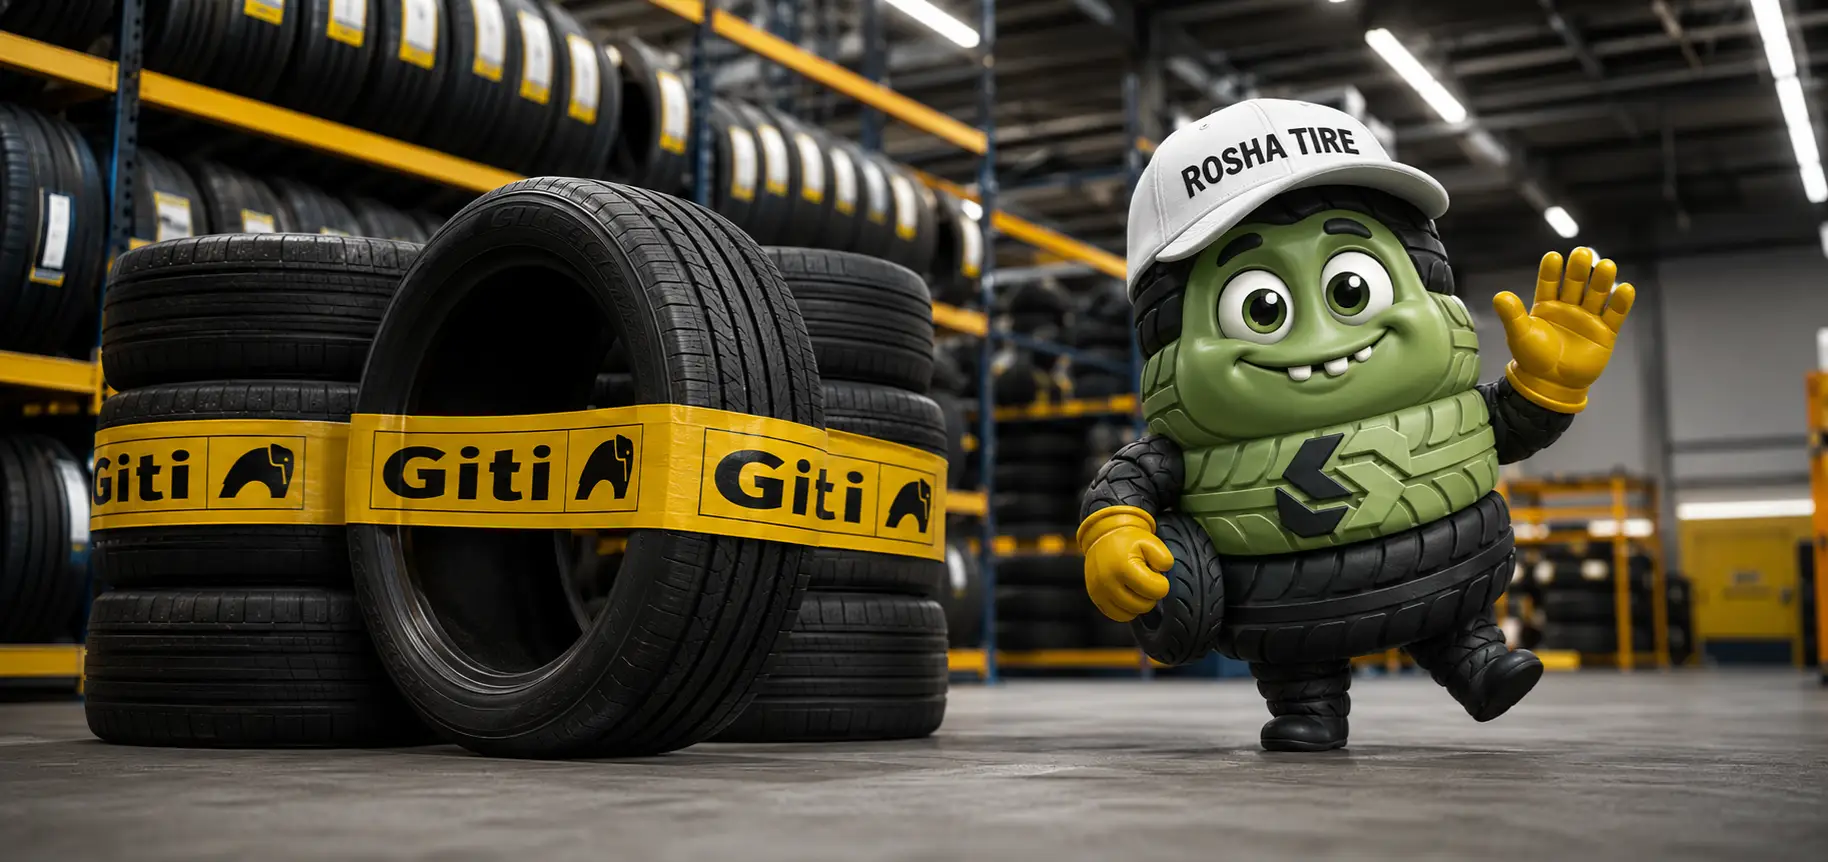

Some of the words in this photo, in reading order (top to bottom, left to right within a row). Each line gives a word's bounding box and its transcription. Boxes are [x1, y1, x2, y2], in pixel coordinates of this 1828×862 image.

[1181, 133, 1288, 199] ROSHA
[1287, 127, 1360, 155] TIRE
[92, 449, 190, 506] Giti
[382, 444, 552, 502] Giti
[714, 449, 864, 524] Giti
